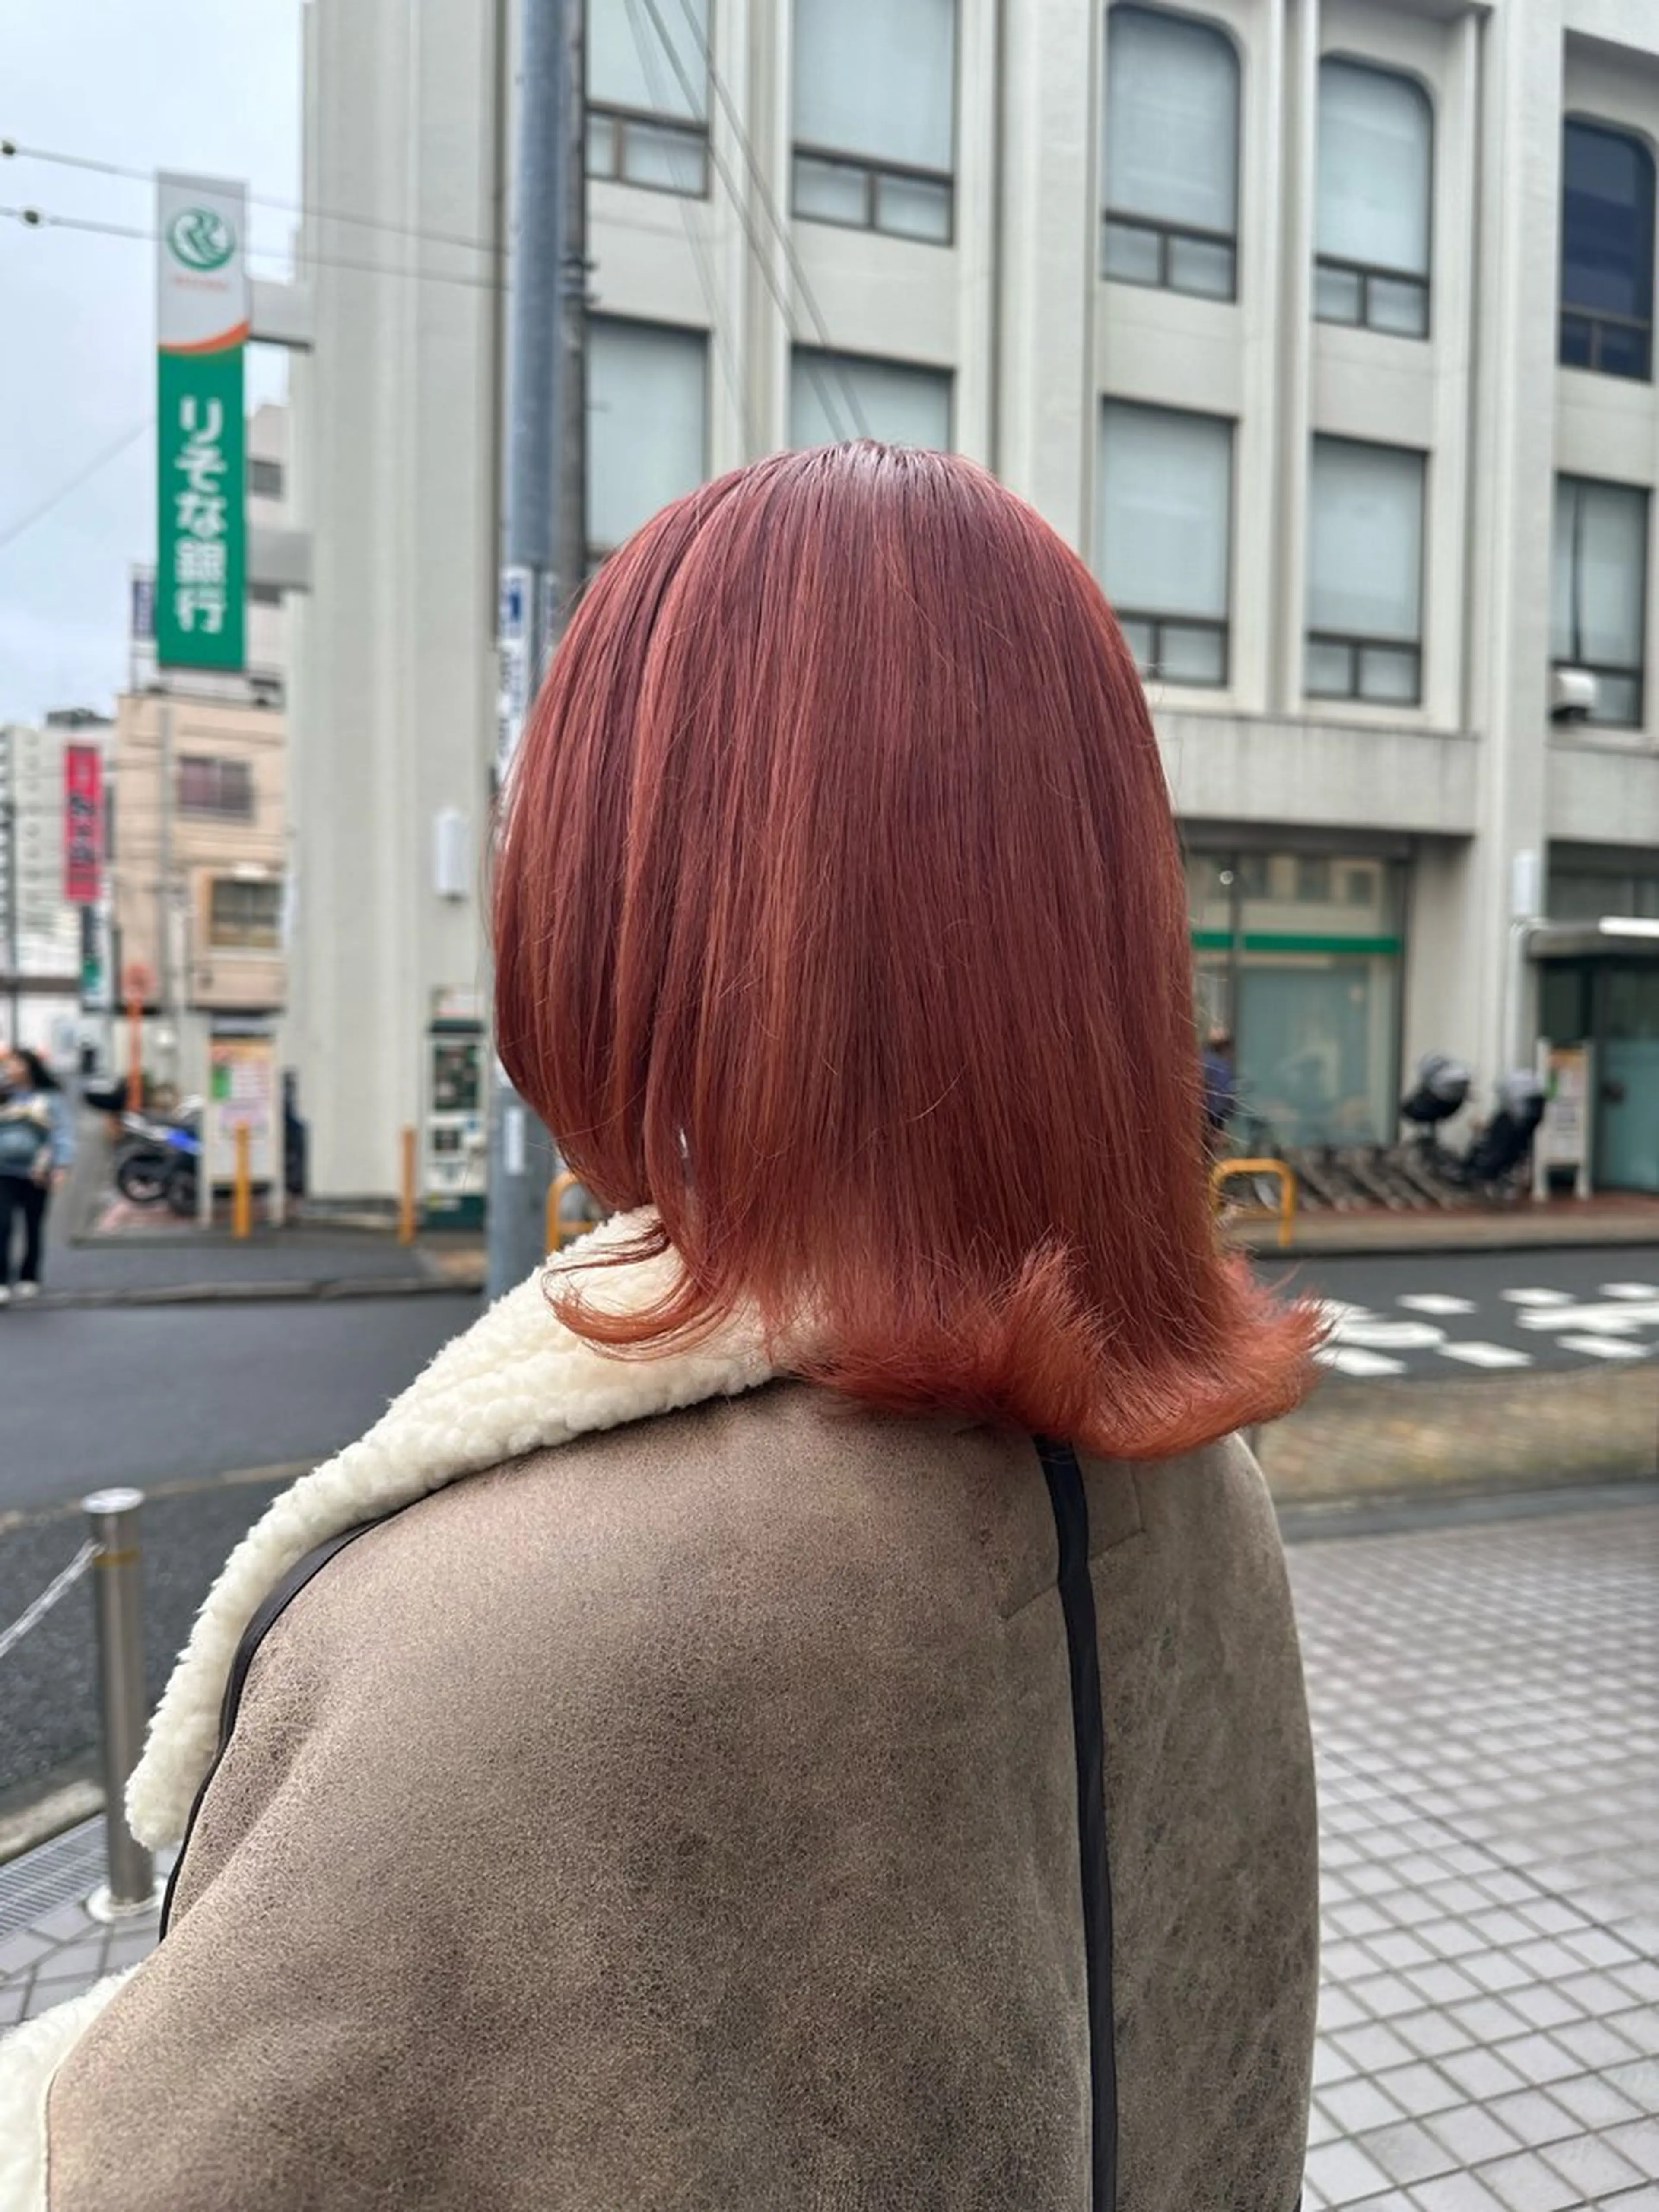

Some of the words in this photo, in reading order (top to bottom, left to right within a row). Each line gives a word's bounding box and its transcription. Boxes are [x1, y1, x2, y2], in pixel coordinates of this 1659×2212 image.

[175, 396, 227, 633] りそな銀行
